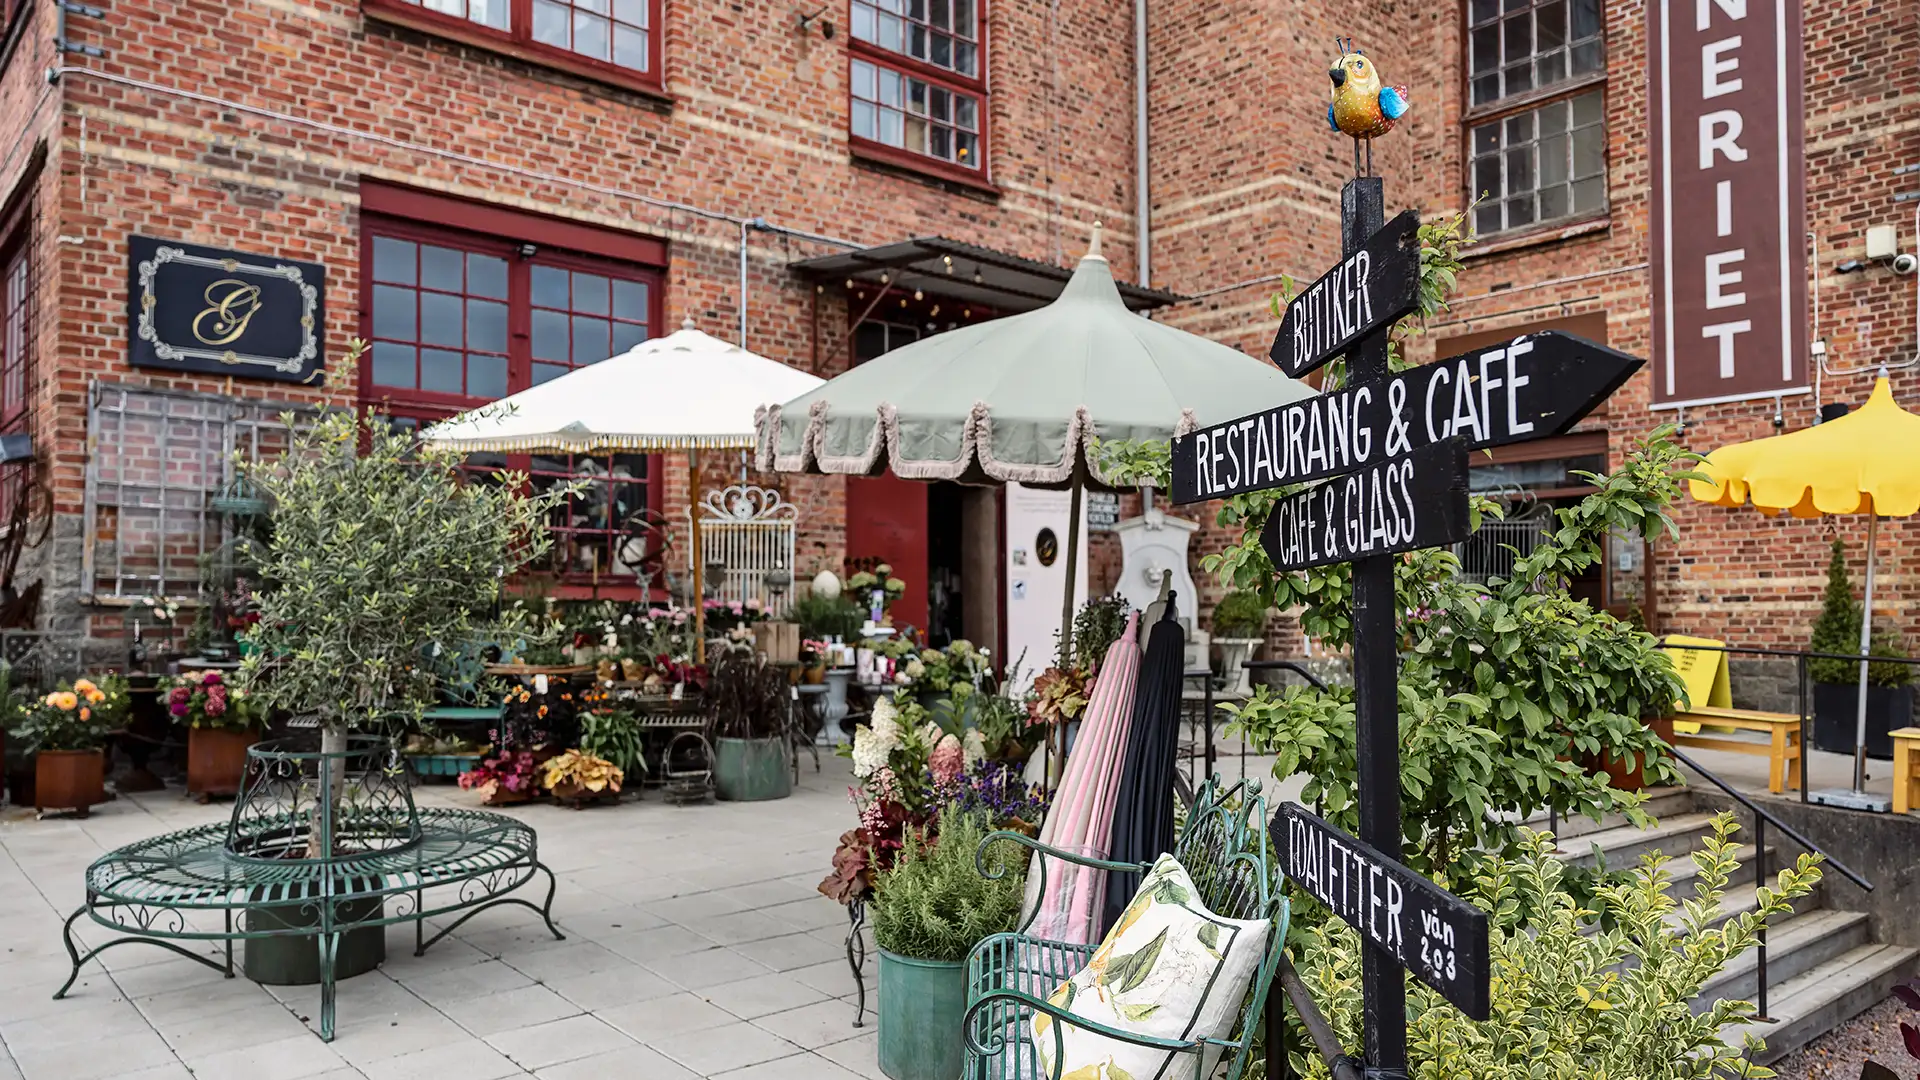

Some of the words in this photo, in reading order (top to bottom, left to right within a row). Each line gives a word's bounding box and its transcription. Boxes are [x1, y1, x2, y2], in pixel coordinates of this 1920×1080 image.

[1293, 250, 1373, 369] BUTIKER
[1196, 387, 1372, 496] RESTAURANG
[1385, 378, 1412, 455] &
[1425, 335, 1534, 443] CAFÉ
[1279, 486, 1318, 565] CAFÉ
[1324, 484, 1338, 558] &
[1344, 458, 1415, 553] GLASS
[1287, 816, 1405, 961] TOALETTER
